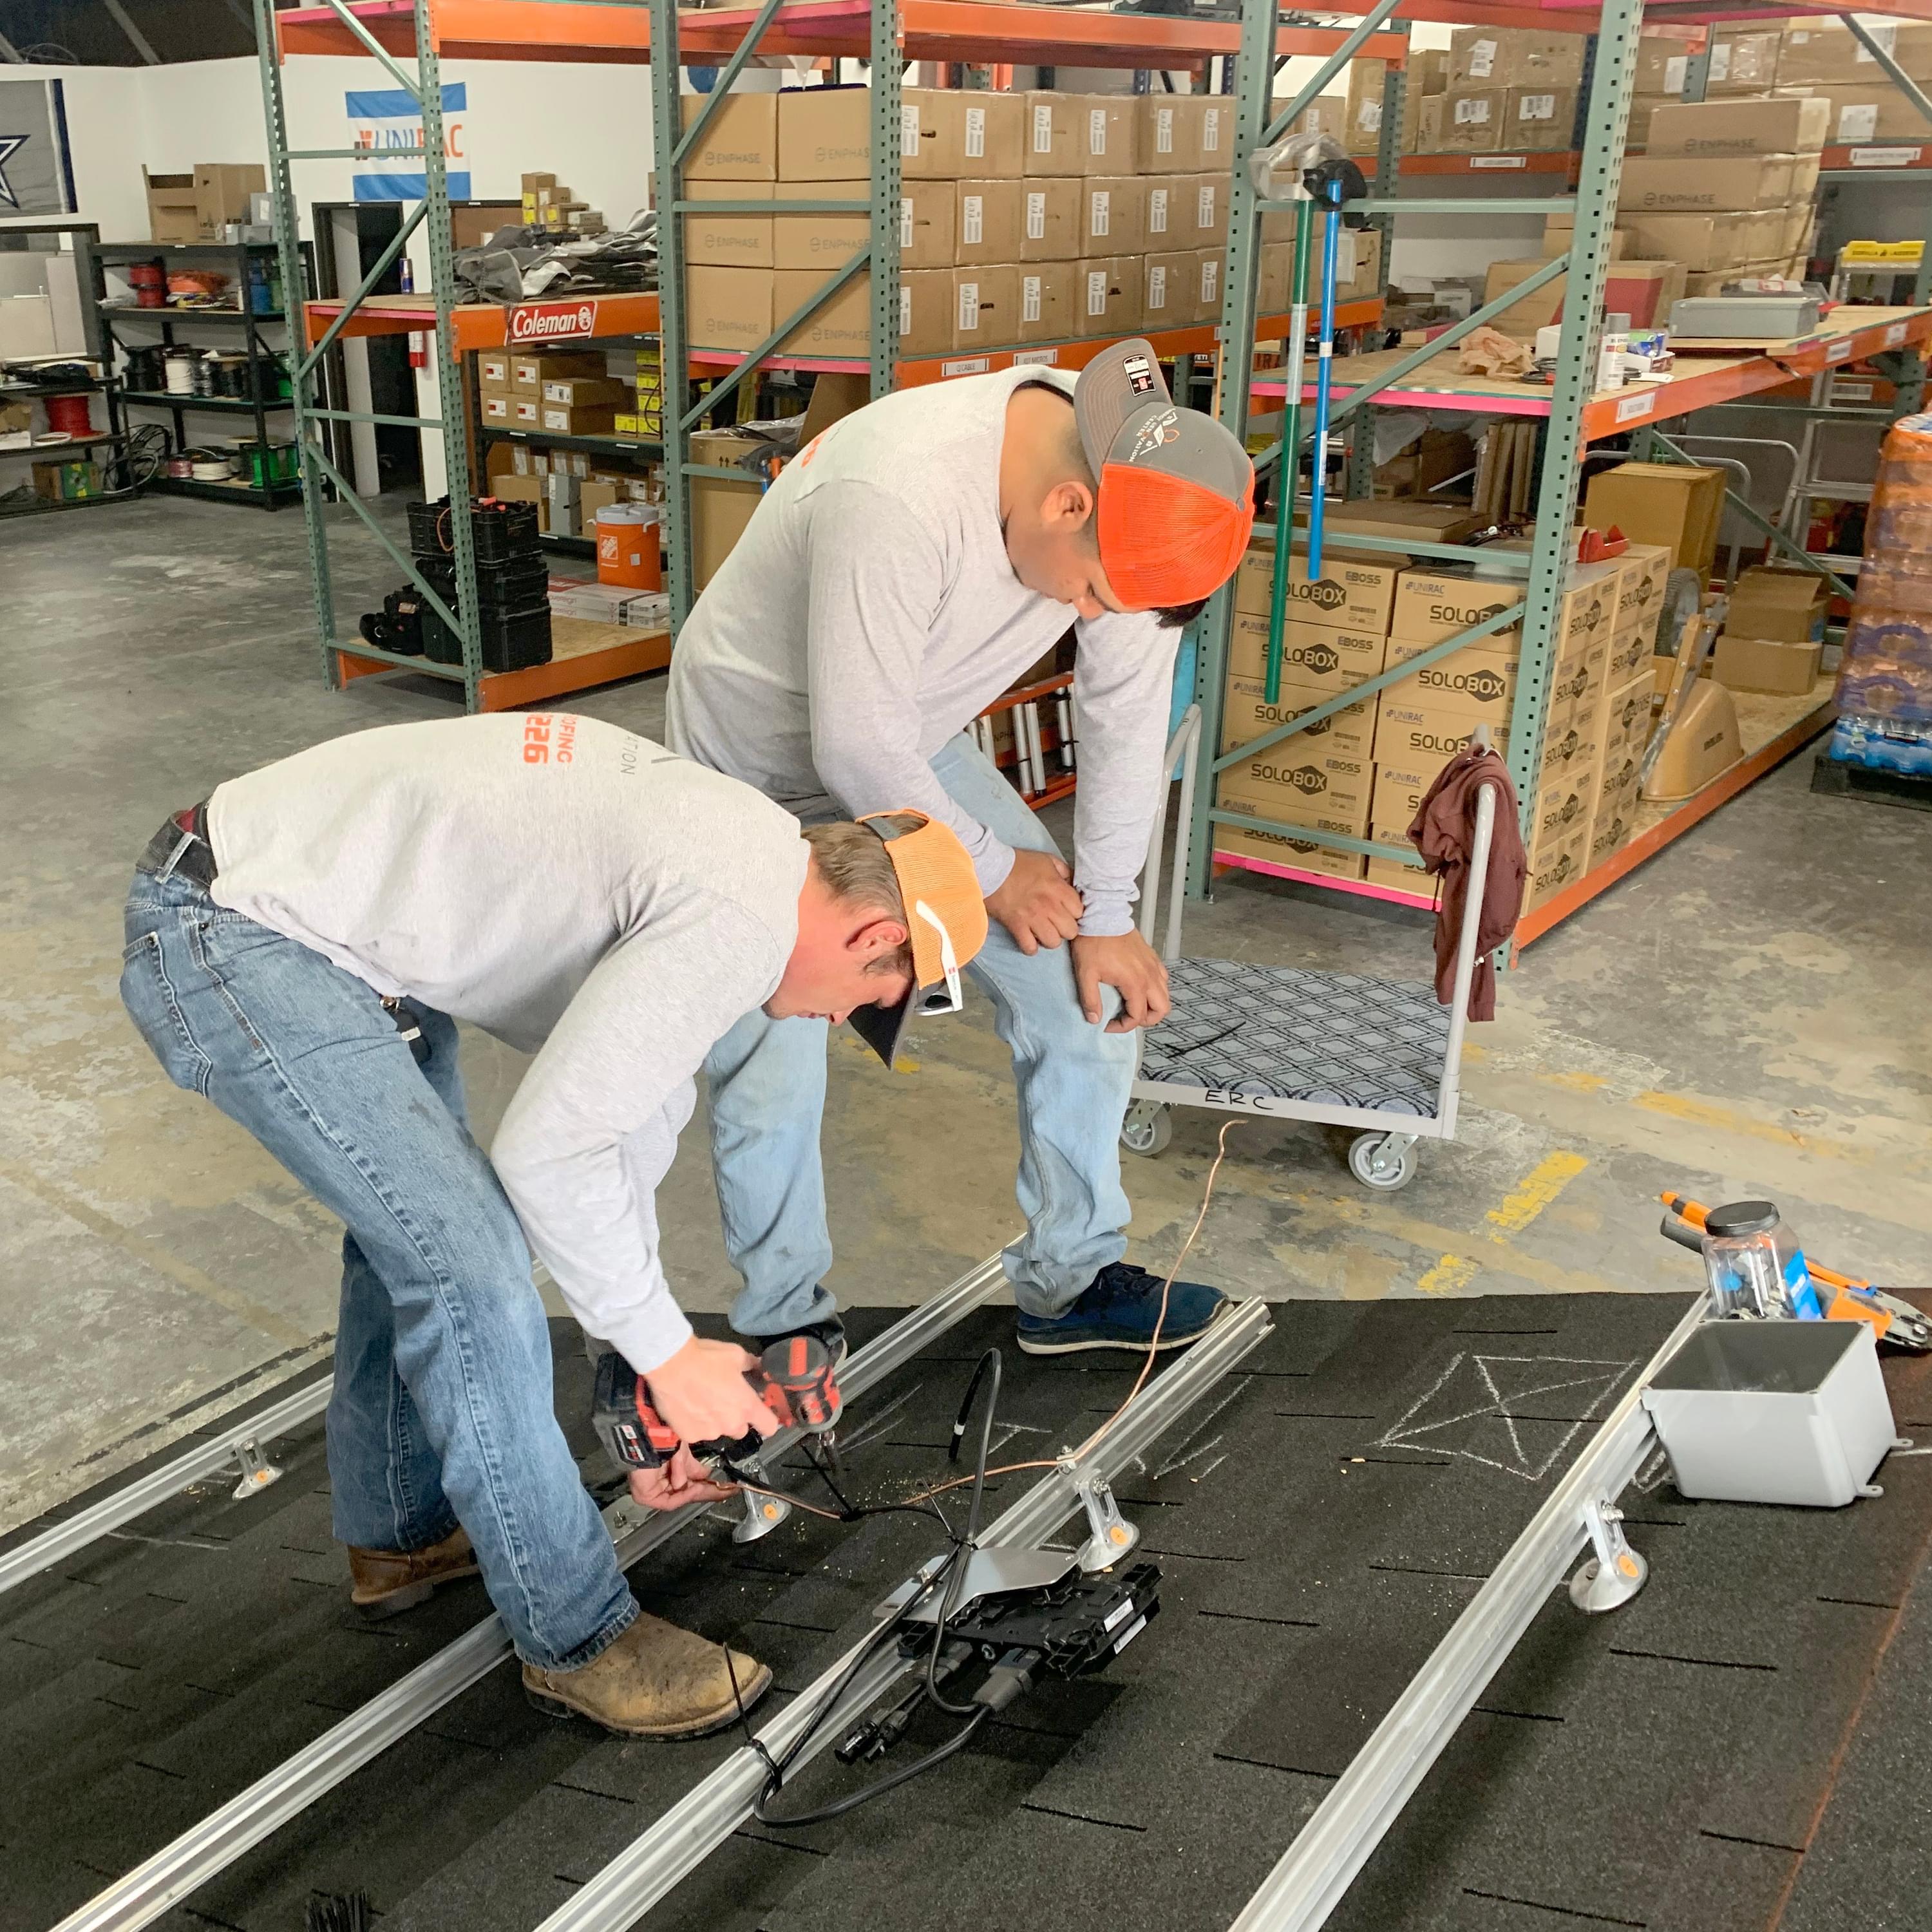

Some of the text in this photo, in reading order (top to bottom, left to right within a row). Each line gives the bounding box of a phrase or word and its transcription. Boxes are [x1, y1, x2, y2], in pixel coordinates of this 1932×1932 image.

[375, 124, 464, 160] UNIC
[717, 153, 761, 164] ENPHASE
[828, 147, 870, 158] ENPHAS
[1660, 193, 1716, 204] ENPHASE
[717, 236, 759, 248] ENPHASE
[513, 309, 577, 337] Coleman
[717, 323, 759, 334] ENPHASE
[1345, 571, 1381, 585] EBOSS
[1414, 583, 1445, 594] UNIRAC
[1247, 621, 1270, 632] UNIRA
[1338, 636, 1374, 650] EBOSS
[1262, 644, 1338, 668] SLOBOX
[1240, 683, 1265, 694] UNIRA
[1419, 670, 1505, 696] SOLOBOX
[1394, 710, 1424, 723] UNIRAC
[1326, 759, 1361, 773] EBOSS
[1251, 764, 1327, 790] SOLOBOX
[1392, 772, 1422, 785] UNIRAC
[1318, 819, 1352, 834] EBOSS
[1206, 1090, 1274, 1110] ERC
